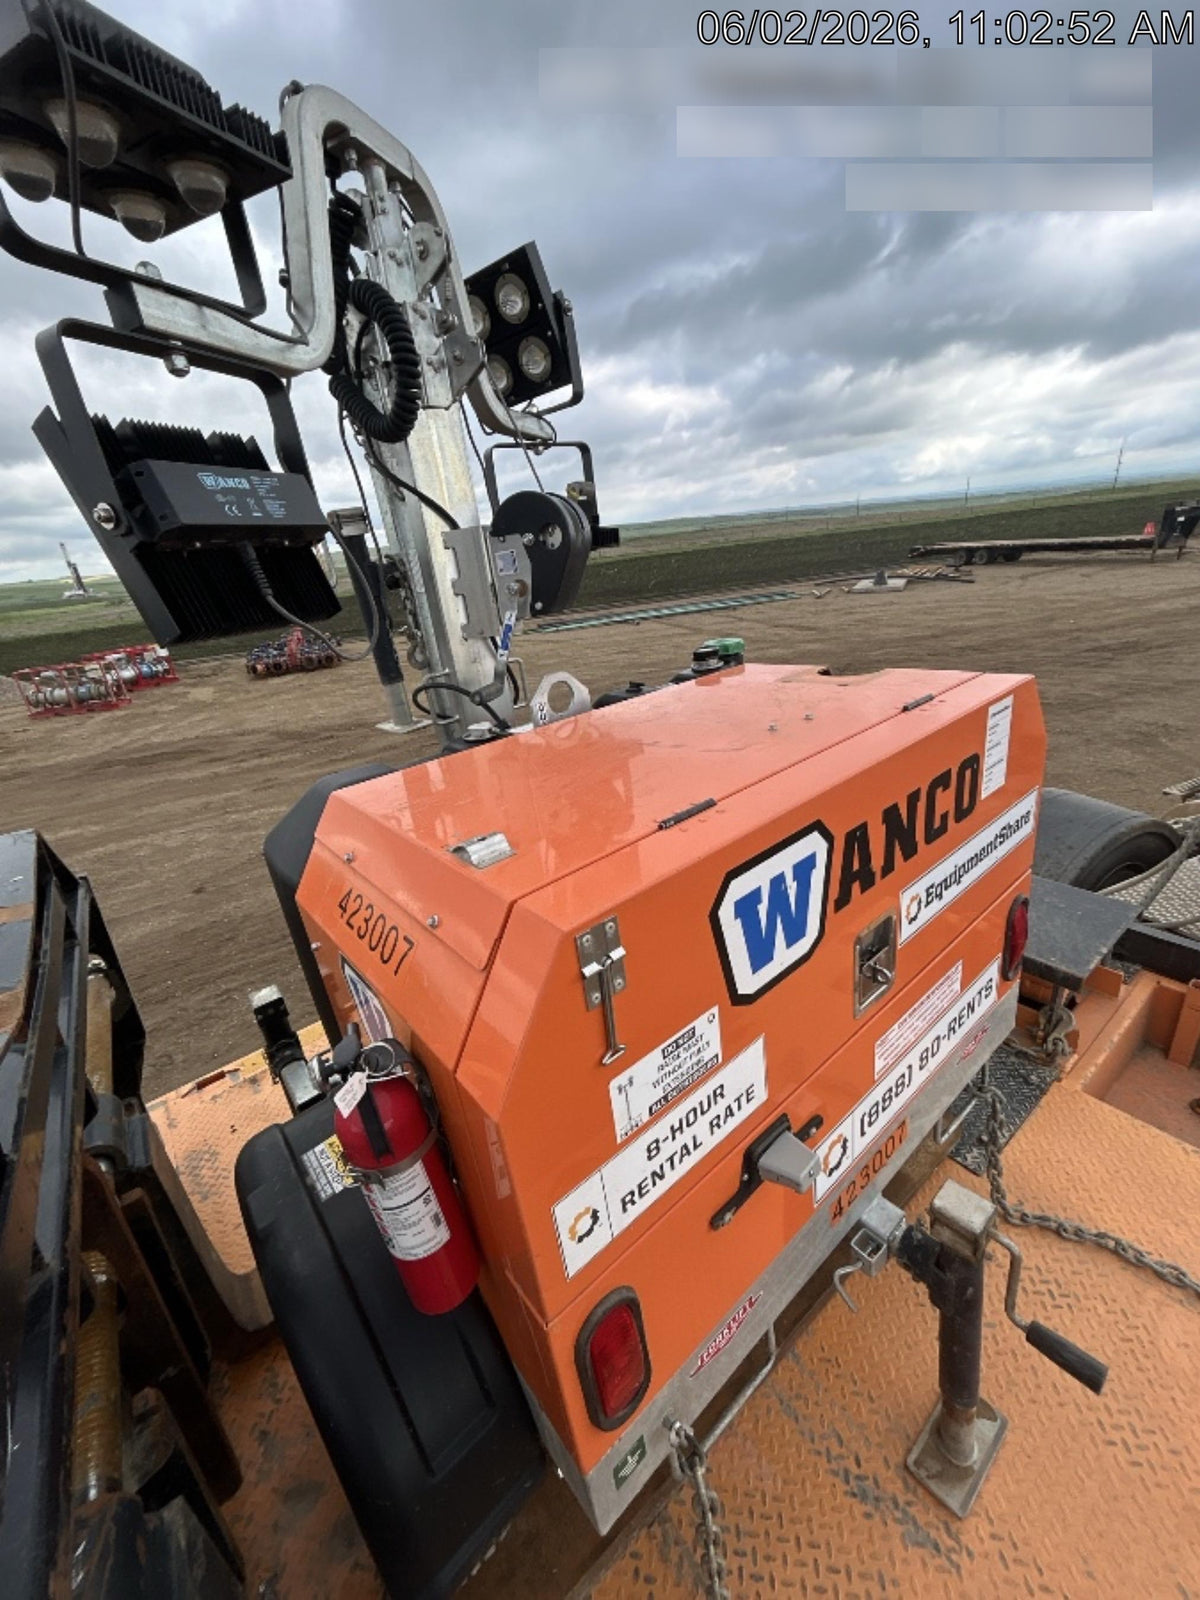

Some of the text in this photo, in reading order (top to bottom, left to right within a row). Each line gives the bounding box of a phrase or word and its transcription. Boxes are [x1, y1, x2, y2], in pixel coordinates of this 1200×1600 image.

[923, 806, 1034, 906] EquipmentShare
[338, 888, 415, 976] 423007
[860, 1065, 913, 1137] (888)
[918, 978, 993, 1072] 80-RENTS
[620, 1084, 756, 1214] RENTAL RATE
[646, 1084, 725, 1161] 8-HOUR
[832, 1121, 907, 1221] 423007
